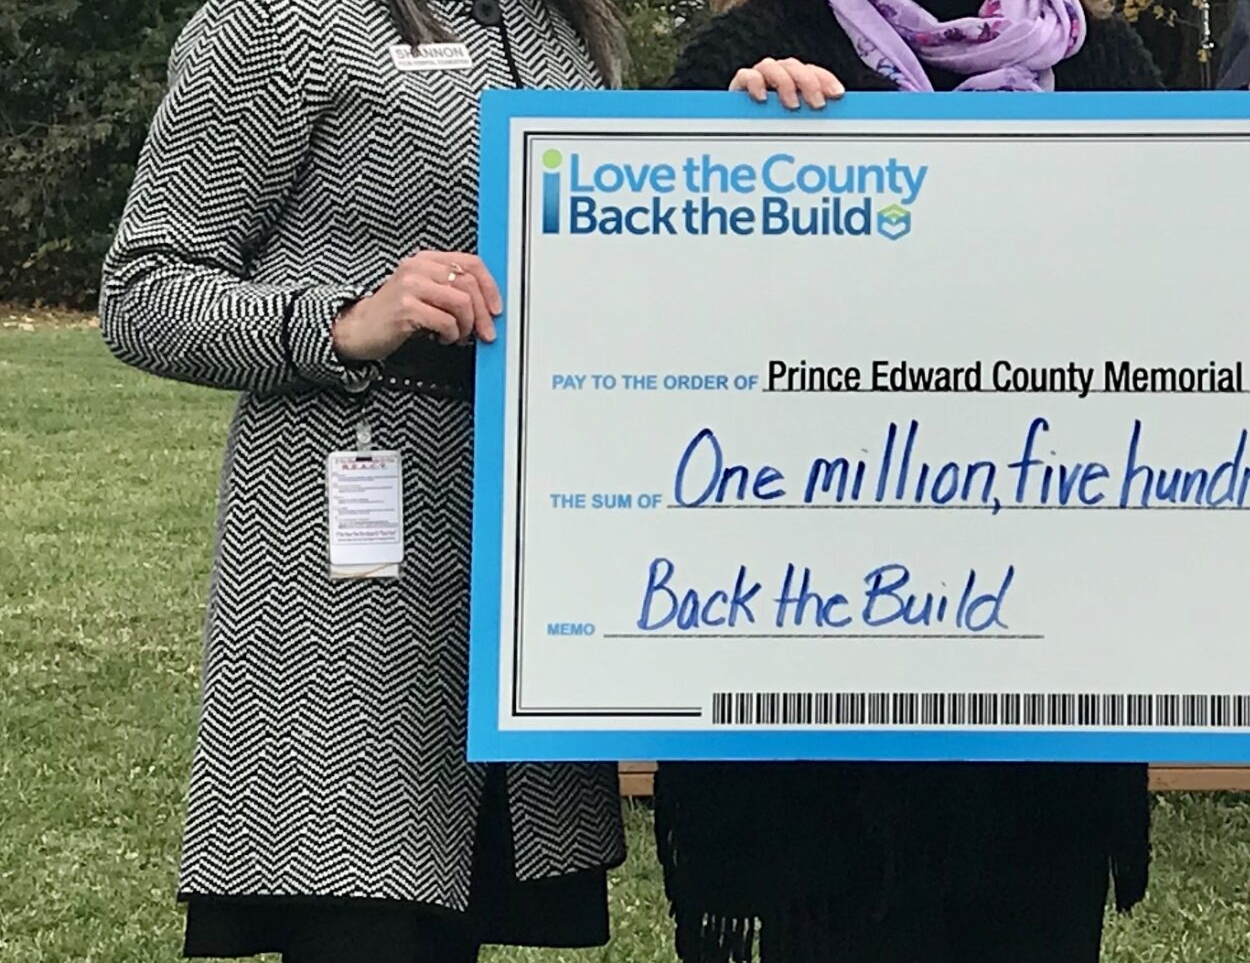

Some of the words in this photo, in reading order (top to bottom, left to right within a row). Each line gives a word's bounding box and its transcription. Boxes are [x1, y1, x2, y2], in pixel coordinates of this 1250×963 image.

[570, 153, 676, 193] Love
[682, 154, 757, 193] the
[761, 153, 928, 205] County
[570, 196, 678, 235] Back
[682, 196, 756, 235] the
[762, 196, 872, 235] Build
[552, 374, 586, 390] PAY
[592, 374, 616, 390] TO
[622, 374, 657, 390] THE
[663, 374, 729, 390] ORDER
[733, 374, 759, 390] OF
[768, 360, 860, 391] Prince
[872, 360, 982, 392] Edward
[992, 360, 1094, 398] County
[1104, 361, 1242, 393] Memorial
[674, 428, 786, 508] One
[1007, 417, 1110, 505] five
[550, 493, 586, 509] THE
[591, 493, 632, 509] SUM
[637, 494, 662, 509] OF
[636, 557, 762, 631] Back
[773, 563, 853, 628] the
[862, 563, 1015, 632] Build
[547, 623, 595, 636] MEMO
